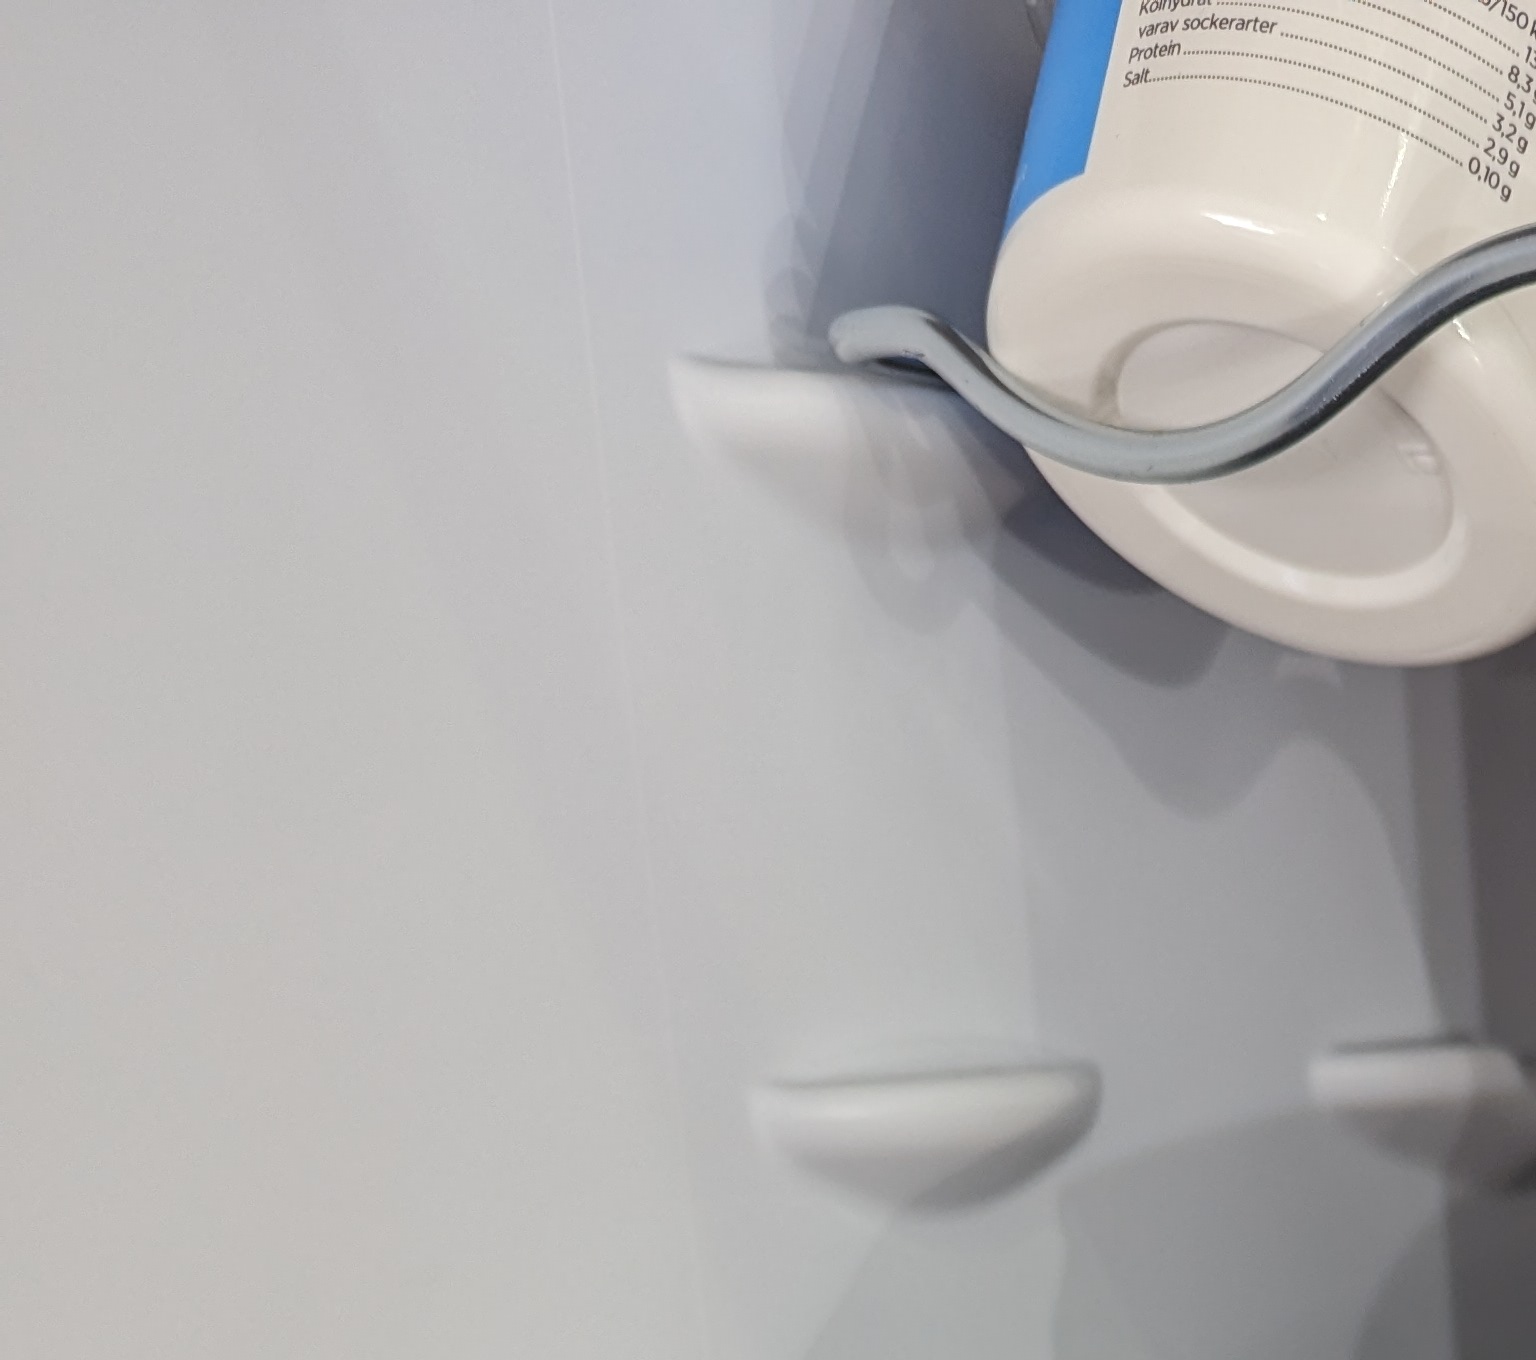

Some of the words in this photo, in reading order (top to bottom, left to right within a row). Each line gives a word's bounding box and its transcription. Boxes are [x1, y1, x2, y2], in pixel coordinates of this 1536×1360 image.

[1138, 19, 1180, 38] varav
[1182, 14, 1278, 35] sockerarter
[1128, 41, 1182, 64] Protein
[1123, 69, 1151, 88] Salt
[1507, 65, 1534, 93] 8,3
[1504, 91, 1526, 119] 5,1
[1492, 113, 1517, 143] 3,2
[1483, 137, 1509, 165] 2,9
[1468, 157, 1500, 189] 0,10
